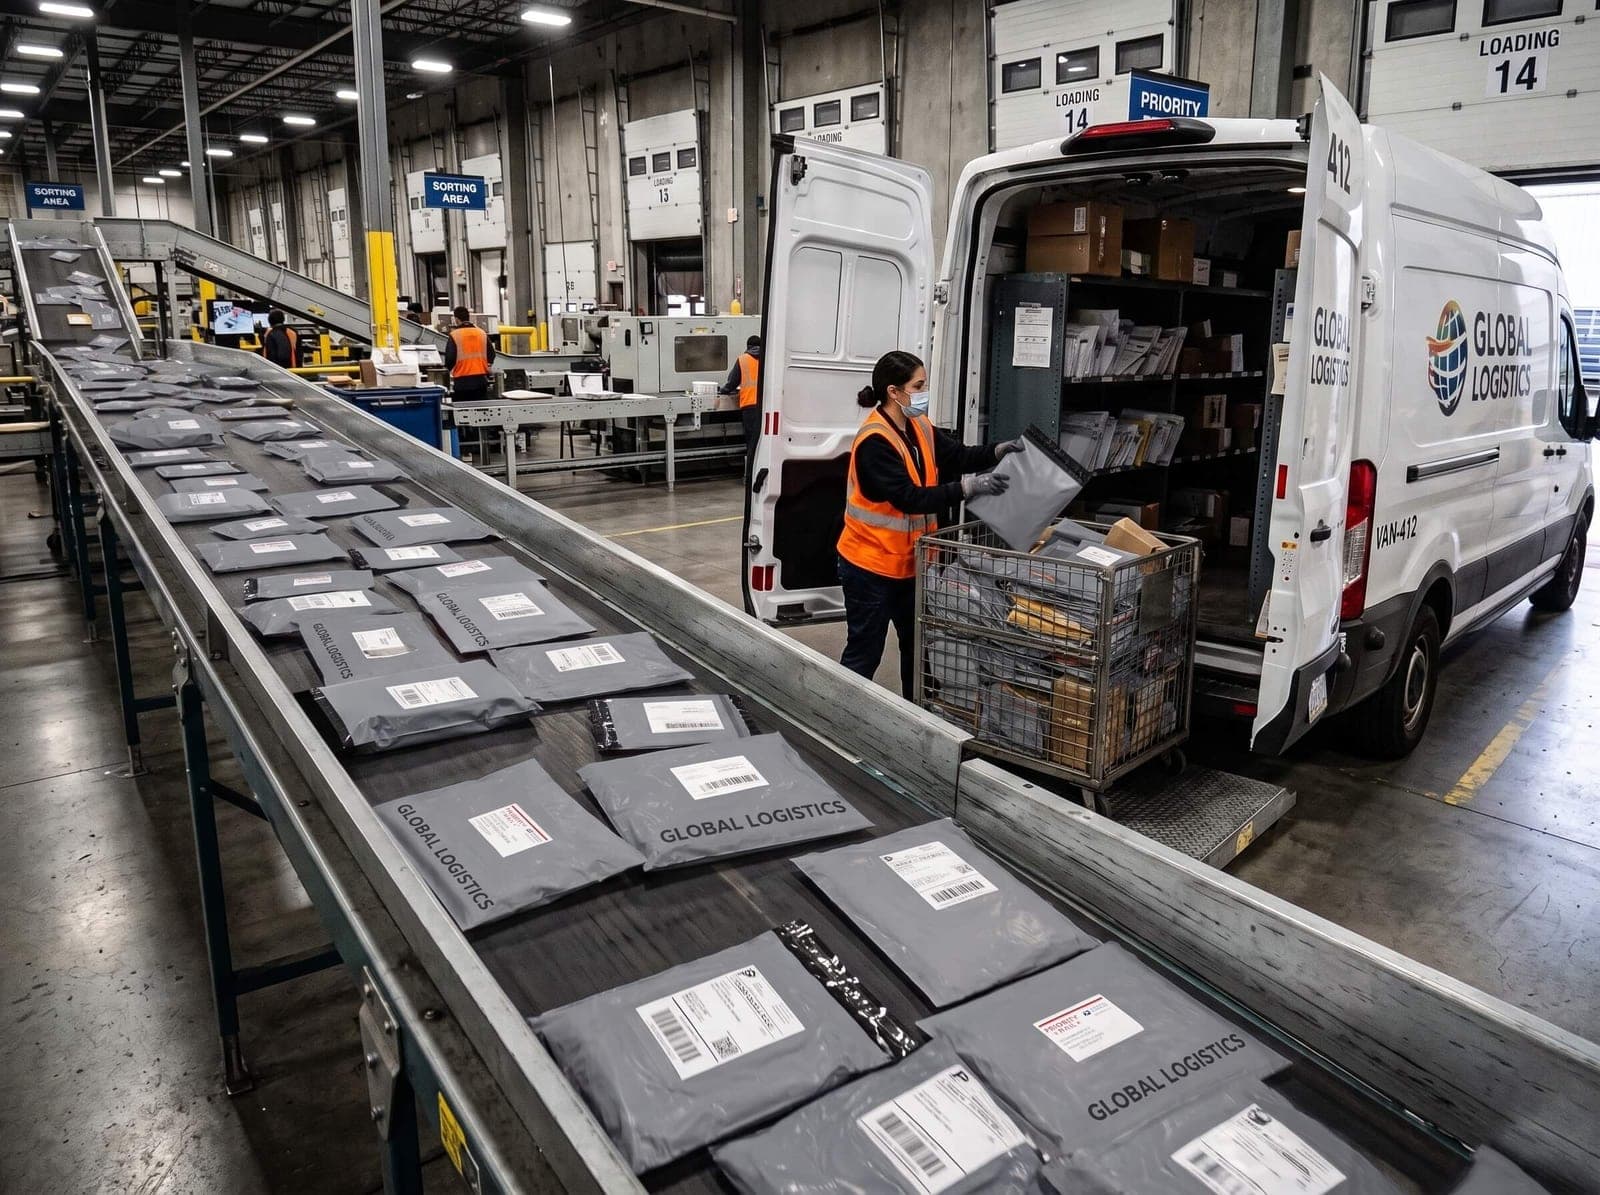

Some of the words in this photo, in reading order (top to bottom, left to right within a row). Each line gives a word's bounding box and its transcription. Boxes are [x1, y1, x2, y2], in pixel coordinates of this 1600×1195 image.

[1479, 29, 1560, 57] LOADING
[1495, 56, 1538, 94] 14
[1056, 88, 1100, 107] LOADING
[1141, 91, 1202, 117] PRIORITY
[1065, 107, 1089, 134] 14
[1327, 132, 1351, 195] 412
[34, 187, 77, 197] SORTING
[432, 181, 477, 193] SORTING
[442, 193, 470, 204] AREA
[1314, 306, 1350, 354] GLOBAL
[1474, 311, 1532, 357] GLOBAL
[1472, 364, 1532, 402] LOGISTICS
[1376, 514, 1418, 550] VAN-412
[660, 817, 744, 843] GLOBAL
[745, 800, 847, 828] LOGISTICS
[397, 803, 441, 849] GLOBAL
[434, 847, 495, 910] LOGISTICS
[1087, 1075, 1166, 1121] GLOBAL
[1159, 1033, 1246, 1084] LOGISTICS
